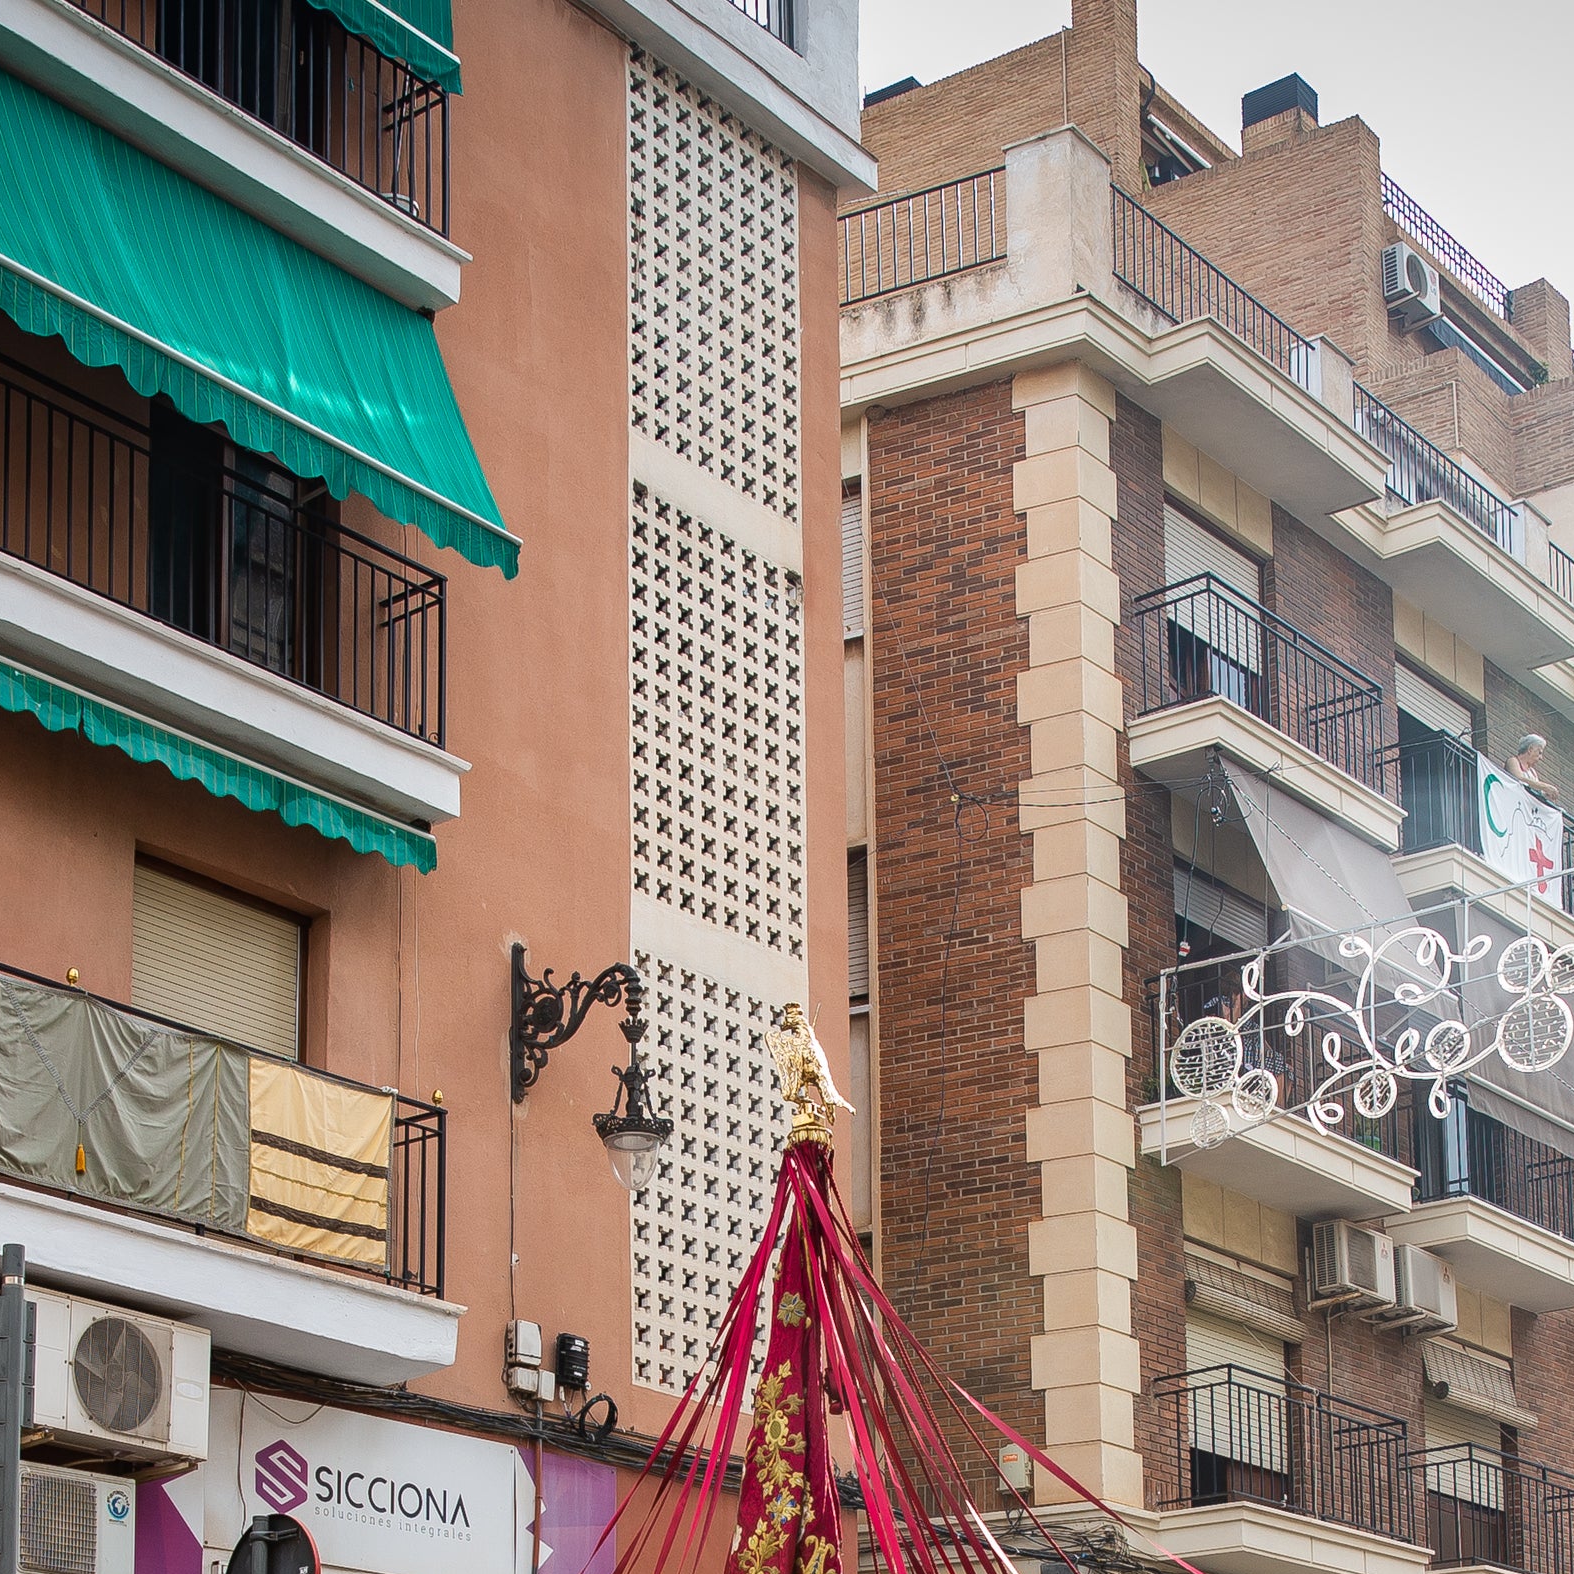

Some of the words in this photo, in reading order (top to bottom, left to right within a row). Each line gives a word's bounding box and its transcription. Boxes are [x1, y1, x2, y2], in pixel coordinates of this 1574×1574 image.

[315, 1465, 471, 1528] SICCIONA
[314, 1505, 392, 1528] soluciones
[399, 1518, 472, 1542] integrales
